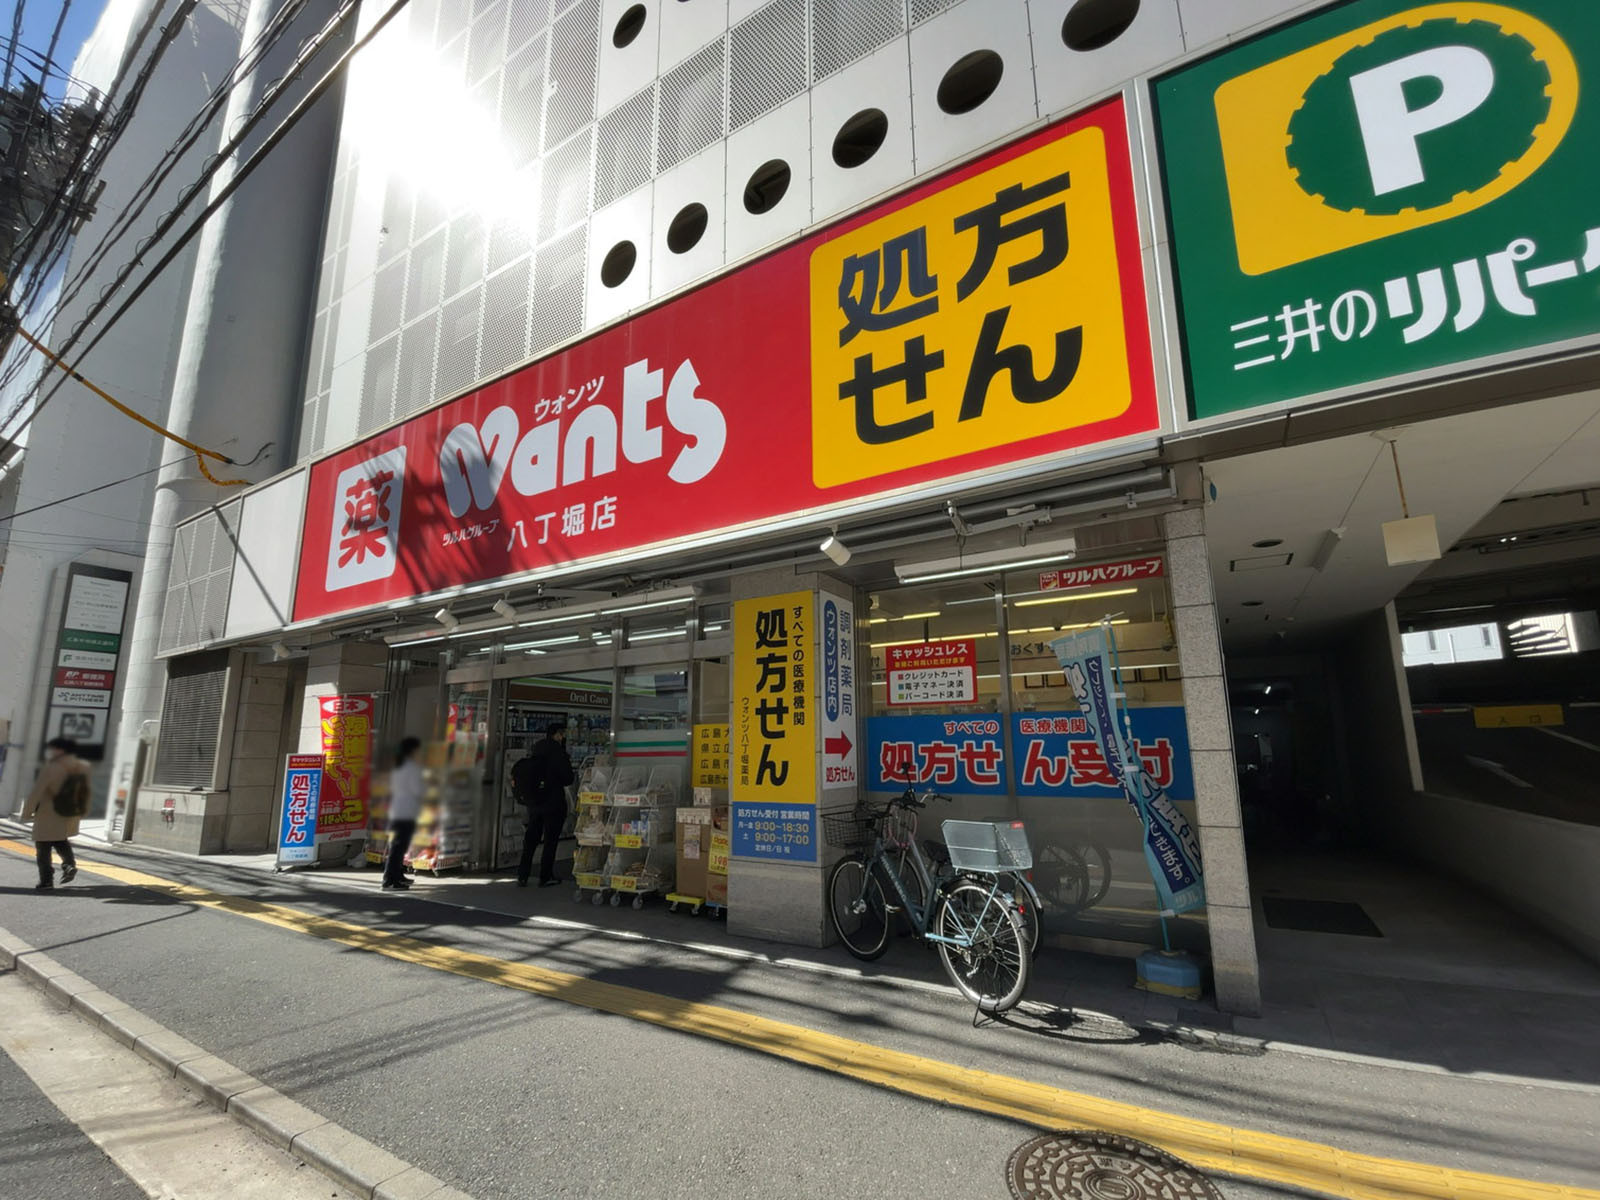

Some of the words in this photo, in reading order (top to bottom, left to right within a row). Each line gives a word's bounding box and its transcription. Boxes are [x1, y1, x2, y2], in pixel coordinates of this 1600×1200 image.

[1349, 45, 1494, 196] P
[839, 171, 1071, 348] 処方
[535, 375, 605, 423] ウォンツ
[838, 304, 1083, 445] せん
[439, 358, 727, 518] Wants
[339, 469, 393, 569] 薬
[442, 518, 500, 548] ツルハグループ
[507, 495, 618, 553] 八丁堀店
[1063, 559, 1160, 585] ツルハグループ
[792, 606, 805, 726] すべての医療機関
[840, 610, 853, 717] 調剤薬局
[892, 643, 968, 659] キャッシュレス
[905, 670, 963, 680] クレジットカード
[570, 692, 587, 702] Oral
[590, 694, 609, 704] Care
[755, 607, 789, 786] 処方せん
[905, 680, 964, 690] 電子マネー決済
[905, 690, 964, 700] バーコード決済
[826, 766, 855, 783] 処方せん
[285, 774, 310, 844] 処方せん
